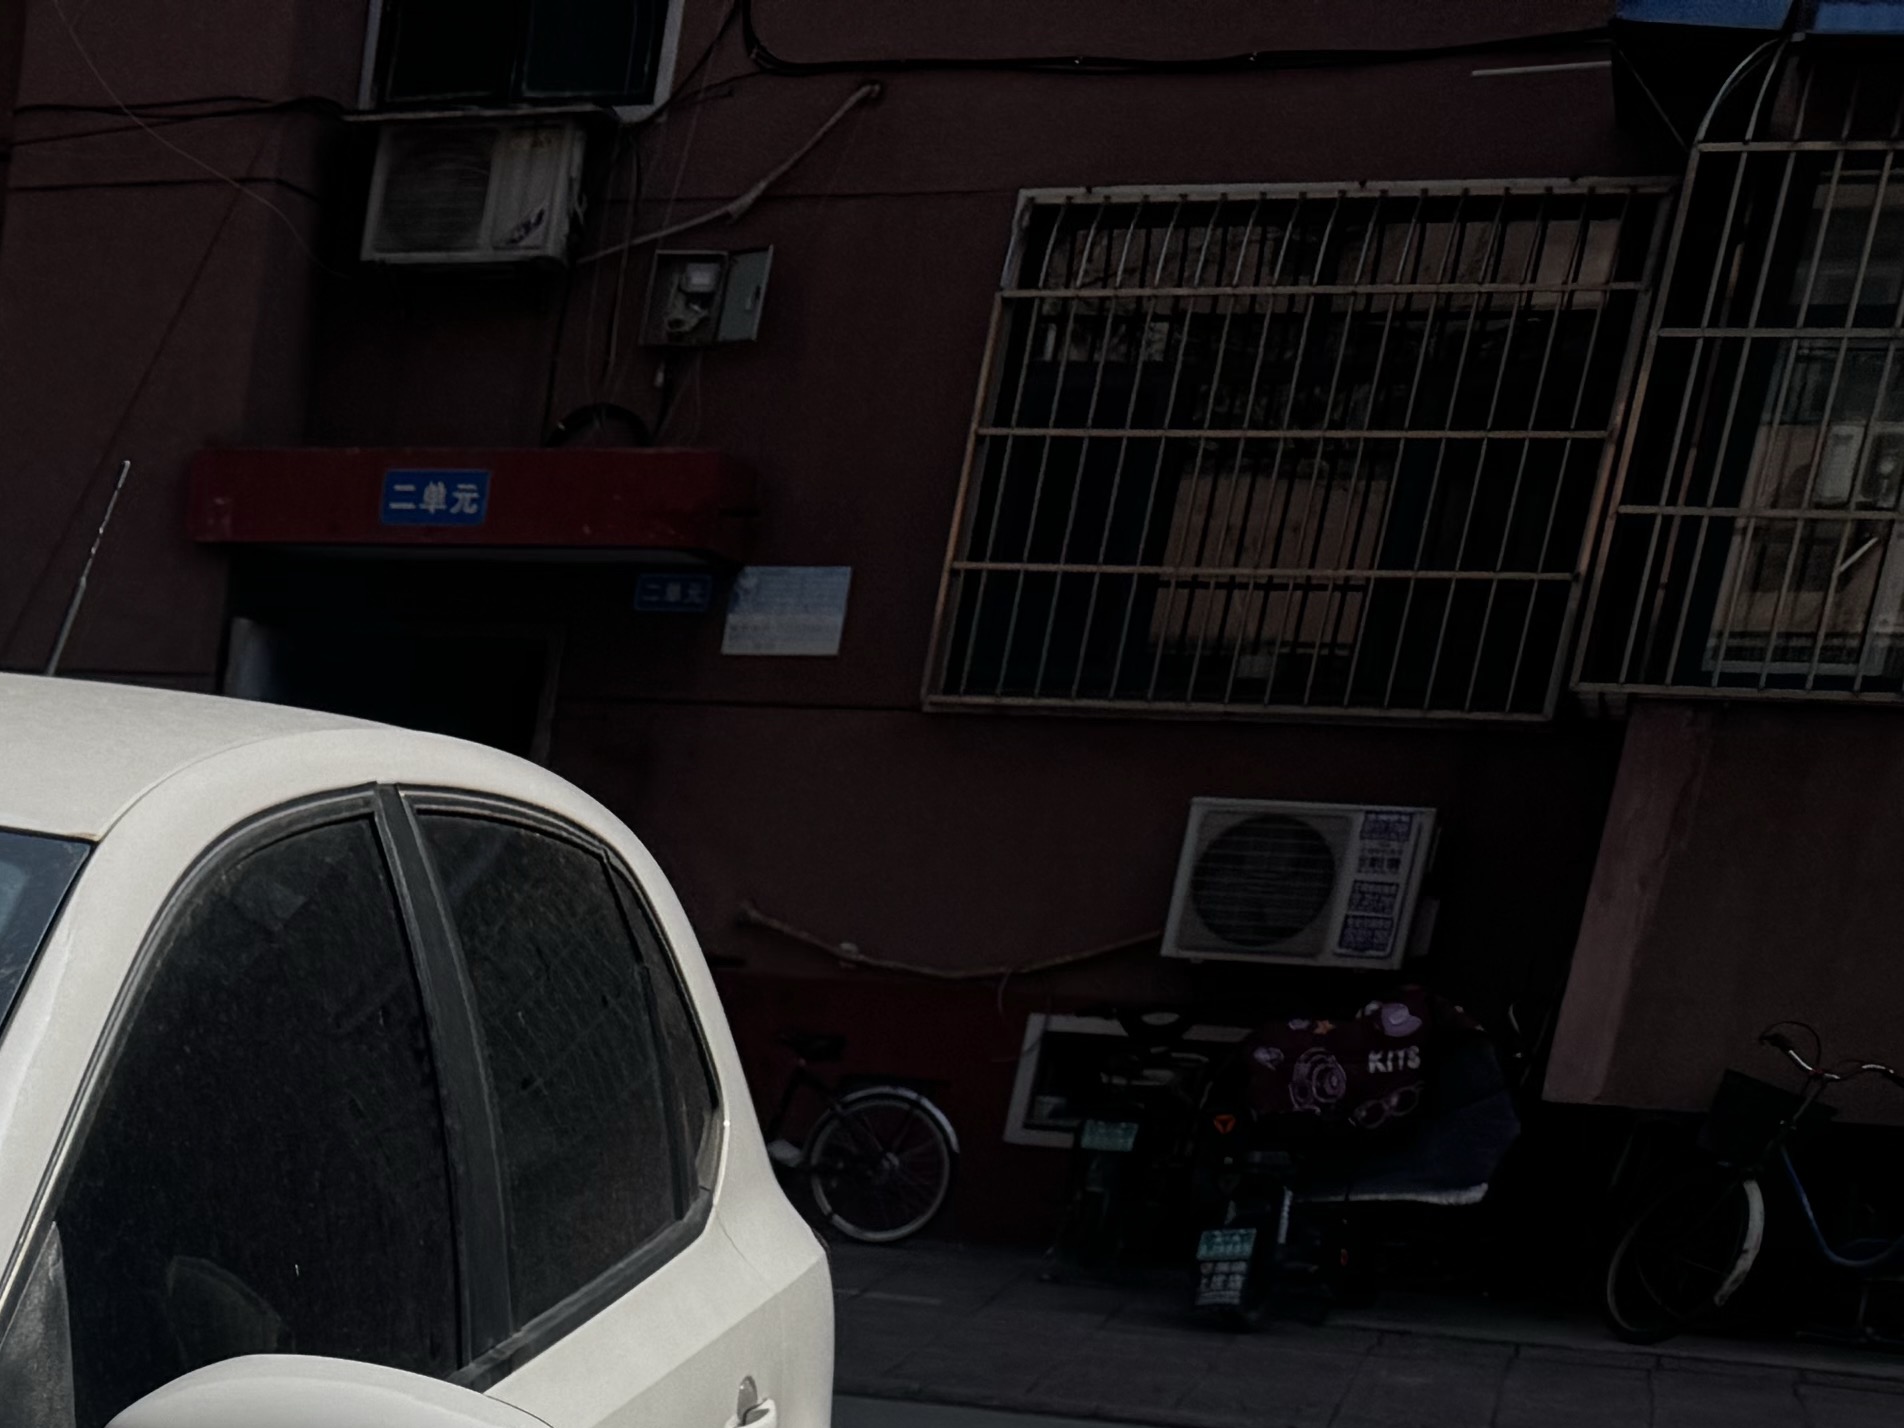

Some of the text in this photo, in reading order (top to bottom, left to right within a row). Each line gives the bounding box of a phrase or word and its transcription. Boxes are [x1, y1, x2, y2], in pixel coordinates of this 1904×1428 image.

[388, 480, 481, 515] 二单元
[1368, 1045, 1421, 1074] KITS
